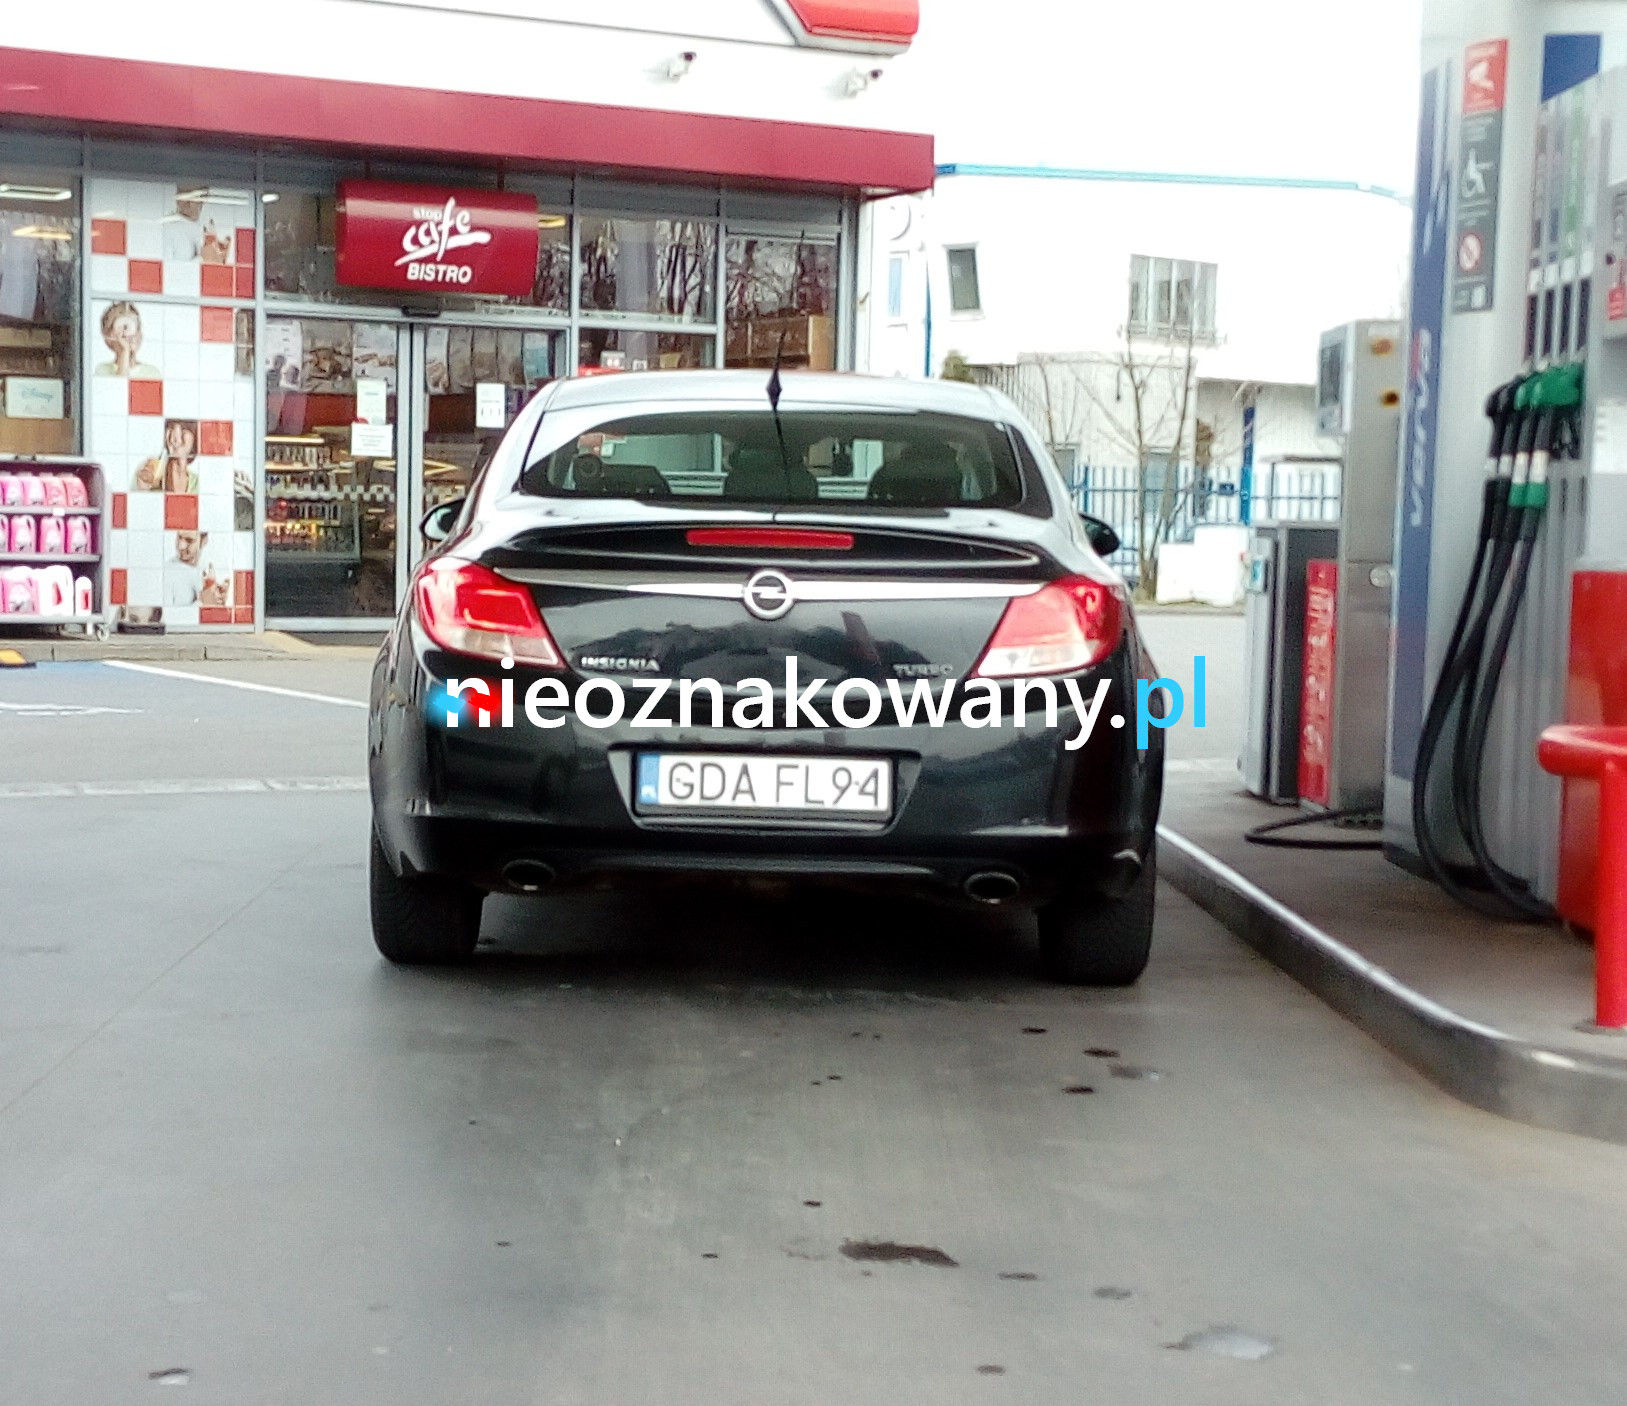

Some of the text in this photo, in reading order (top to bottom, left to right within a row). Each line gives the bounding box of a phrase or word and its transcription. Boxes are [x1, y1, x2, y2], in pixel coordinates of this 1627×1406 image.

[406, 262, 472, 284] BISTRO
[581, 656, 660, 672] INSIGNIA
[893, 663, 953, 678] TURBO
[668, 762, 879, 807] GDA FL94
